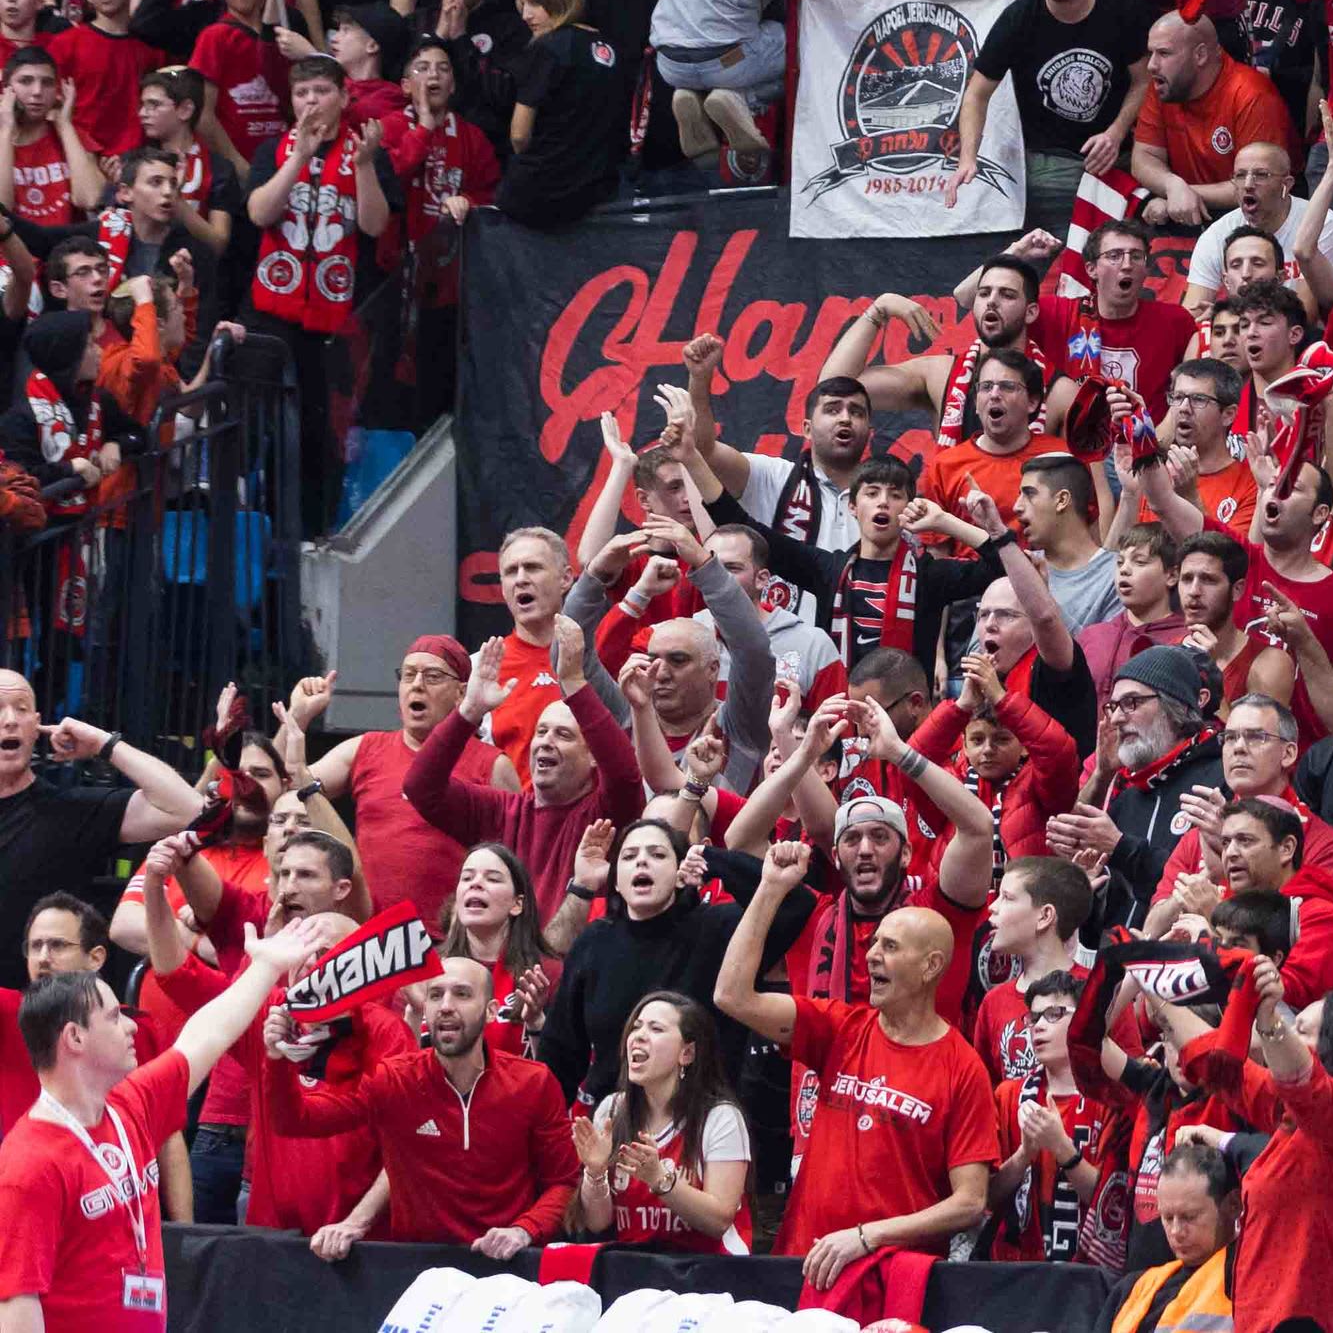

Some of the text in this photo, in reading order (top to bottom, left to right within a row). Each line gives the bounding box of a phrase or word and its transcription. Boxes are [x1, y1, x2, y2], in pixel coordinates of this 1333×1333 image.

[872, 1, 959, 43] HAPOEL JERUSALEM
[830, 1076, 932, 1124] JERUSALEM
